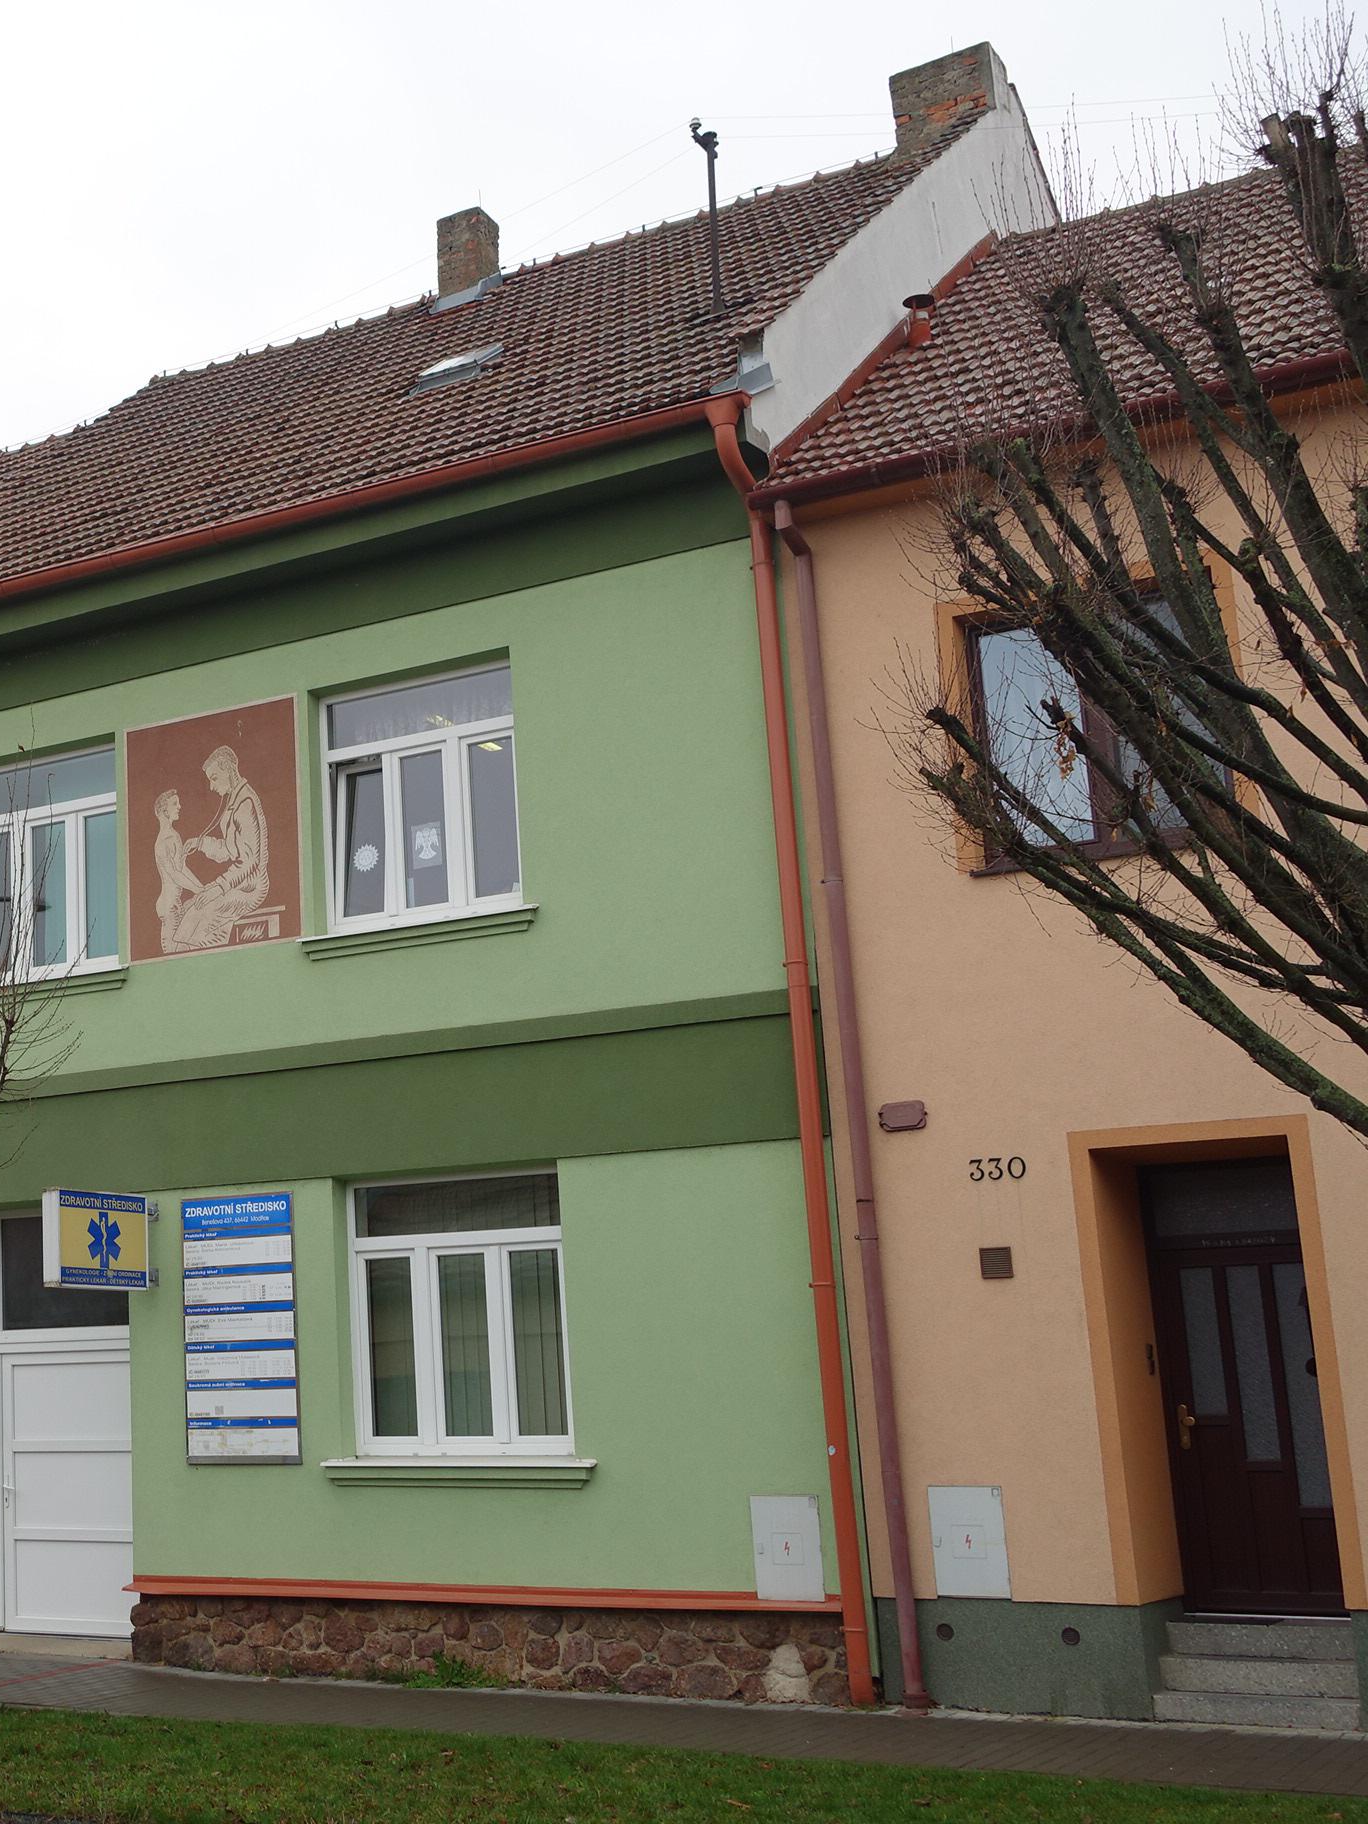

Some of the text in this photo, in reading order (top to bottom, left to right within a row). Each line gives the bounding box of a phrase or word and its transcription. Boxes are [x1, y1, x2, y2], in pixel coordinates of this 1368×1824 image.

[969, 1156, 1026, 1181] 330
[60, 1195, 143, 1211] ZDRAVOTNÍ STŘEDISKO
[185, 1200, 287, 1218] ZDRAVOTNÍ STŘEDISKO
[65, 1268, 100, 1276] GYNEKOLOGIE
